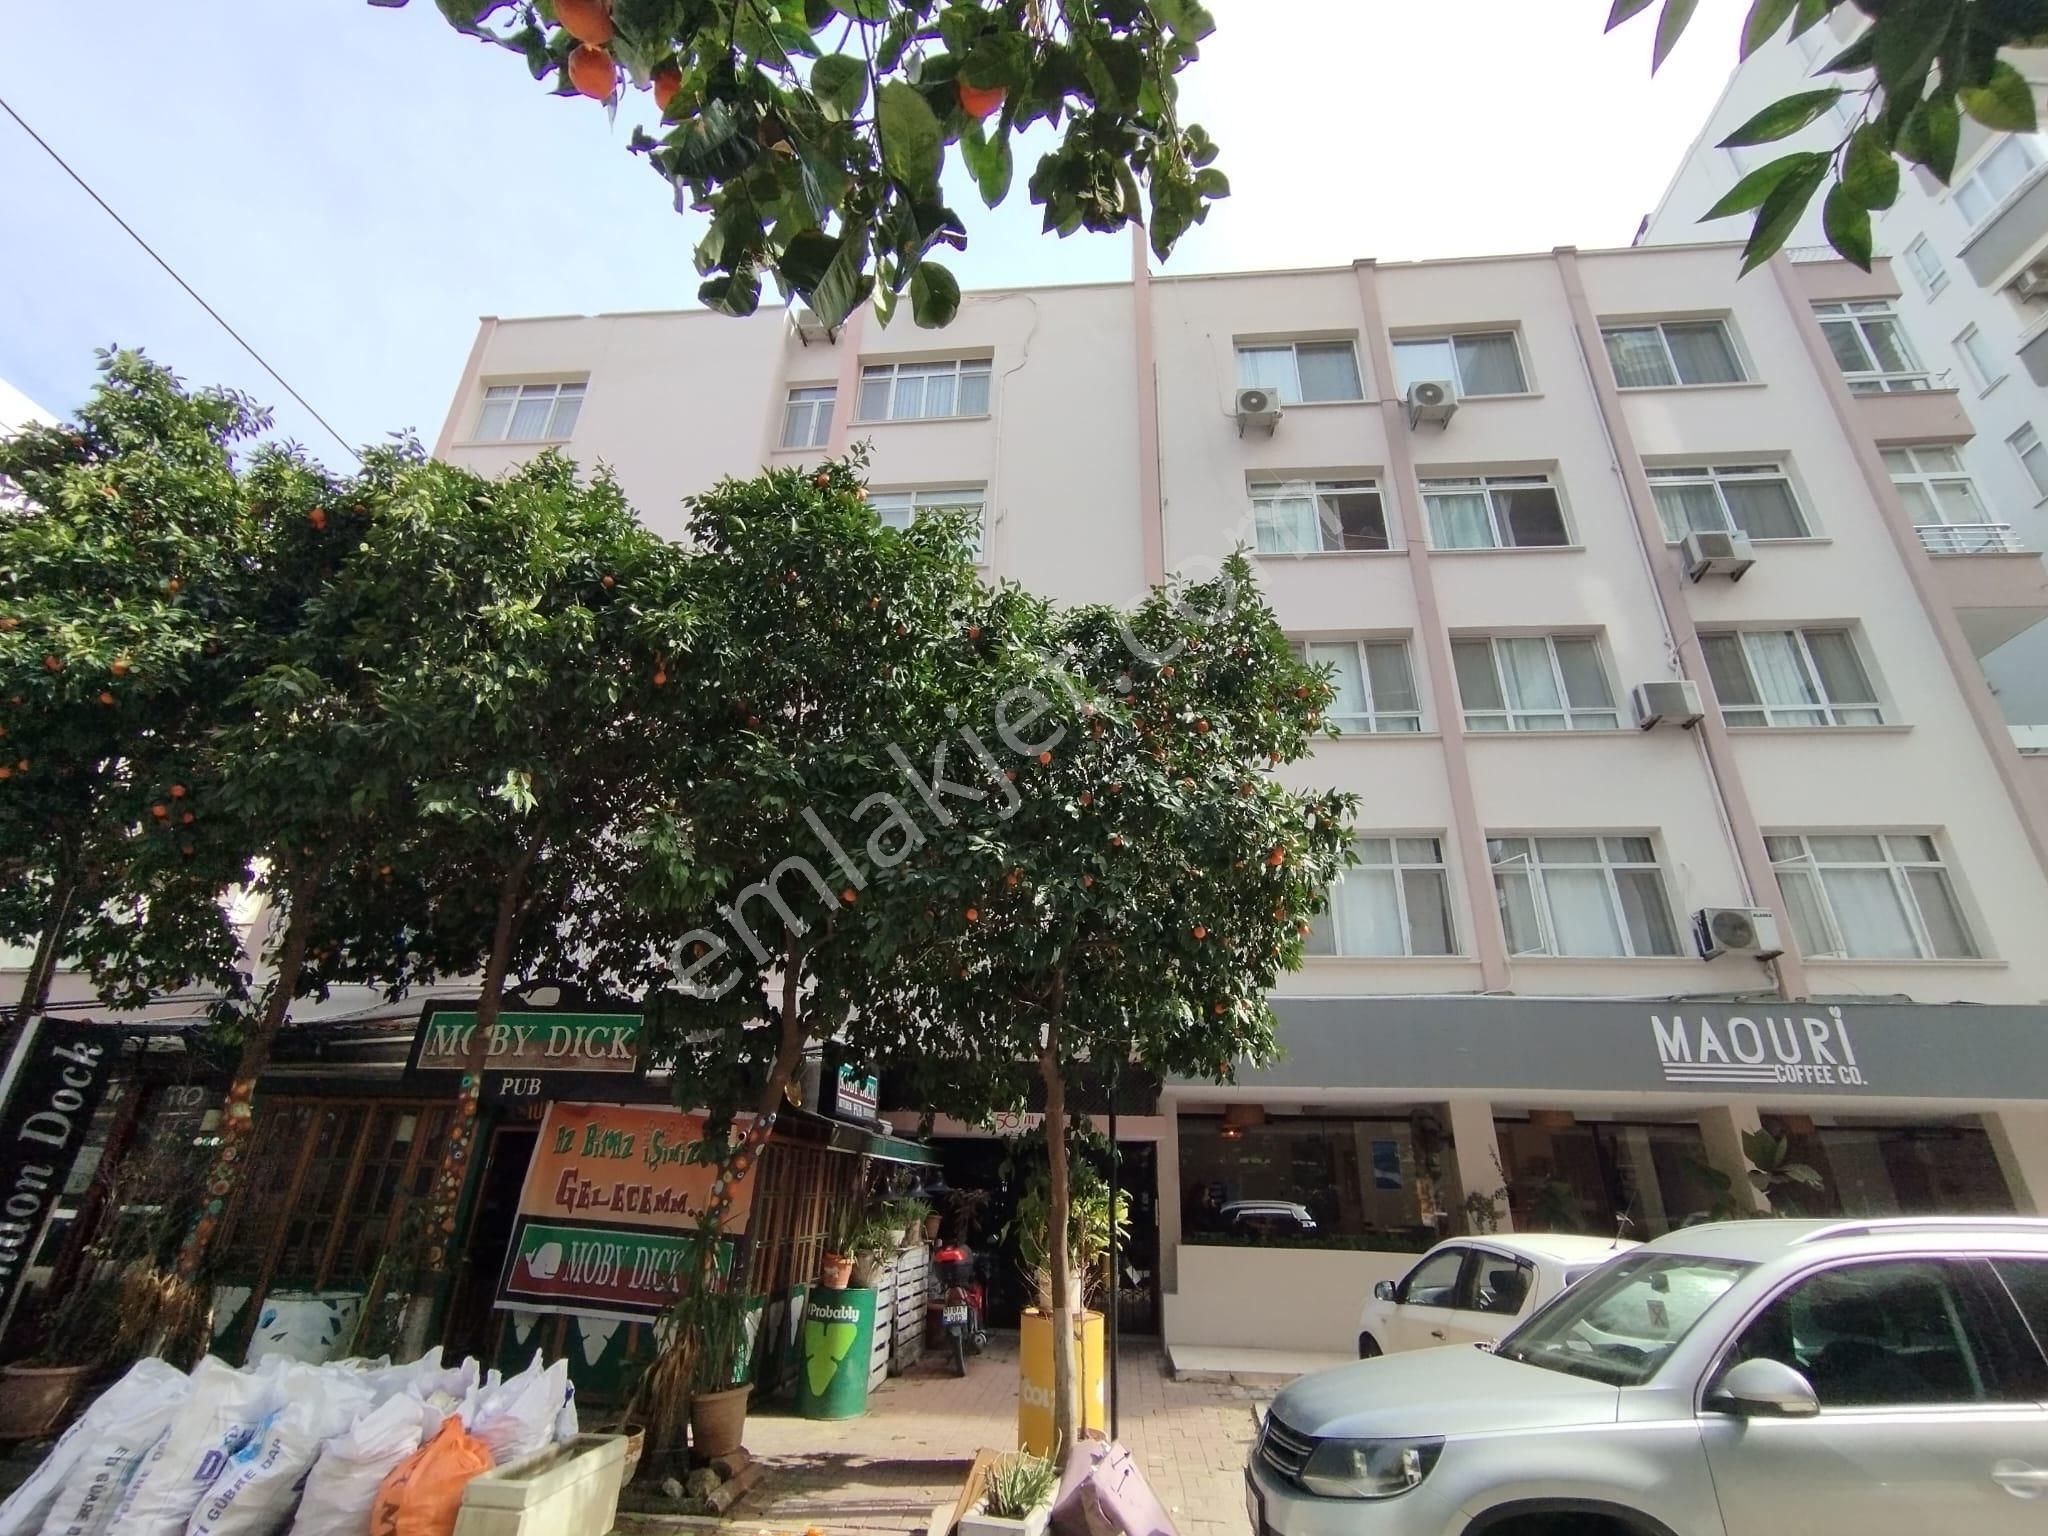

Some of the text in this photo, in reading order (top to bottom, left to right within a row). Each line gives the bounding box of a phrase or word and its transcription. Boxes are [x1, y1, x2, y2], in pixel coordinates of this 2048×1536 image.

[544, 1025, 636, 1060] DICK
[500, 1078, 542, 1097] PUB
[1774, 1064, 1869, 1086] COFFEE CO.
[17, 1041, 104, 1150] Dock
[562, 1240, 686, 1294] MOBY DICK
[809, 1303, 860, 1323] Probably
